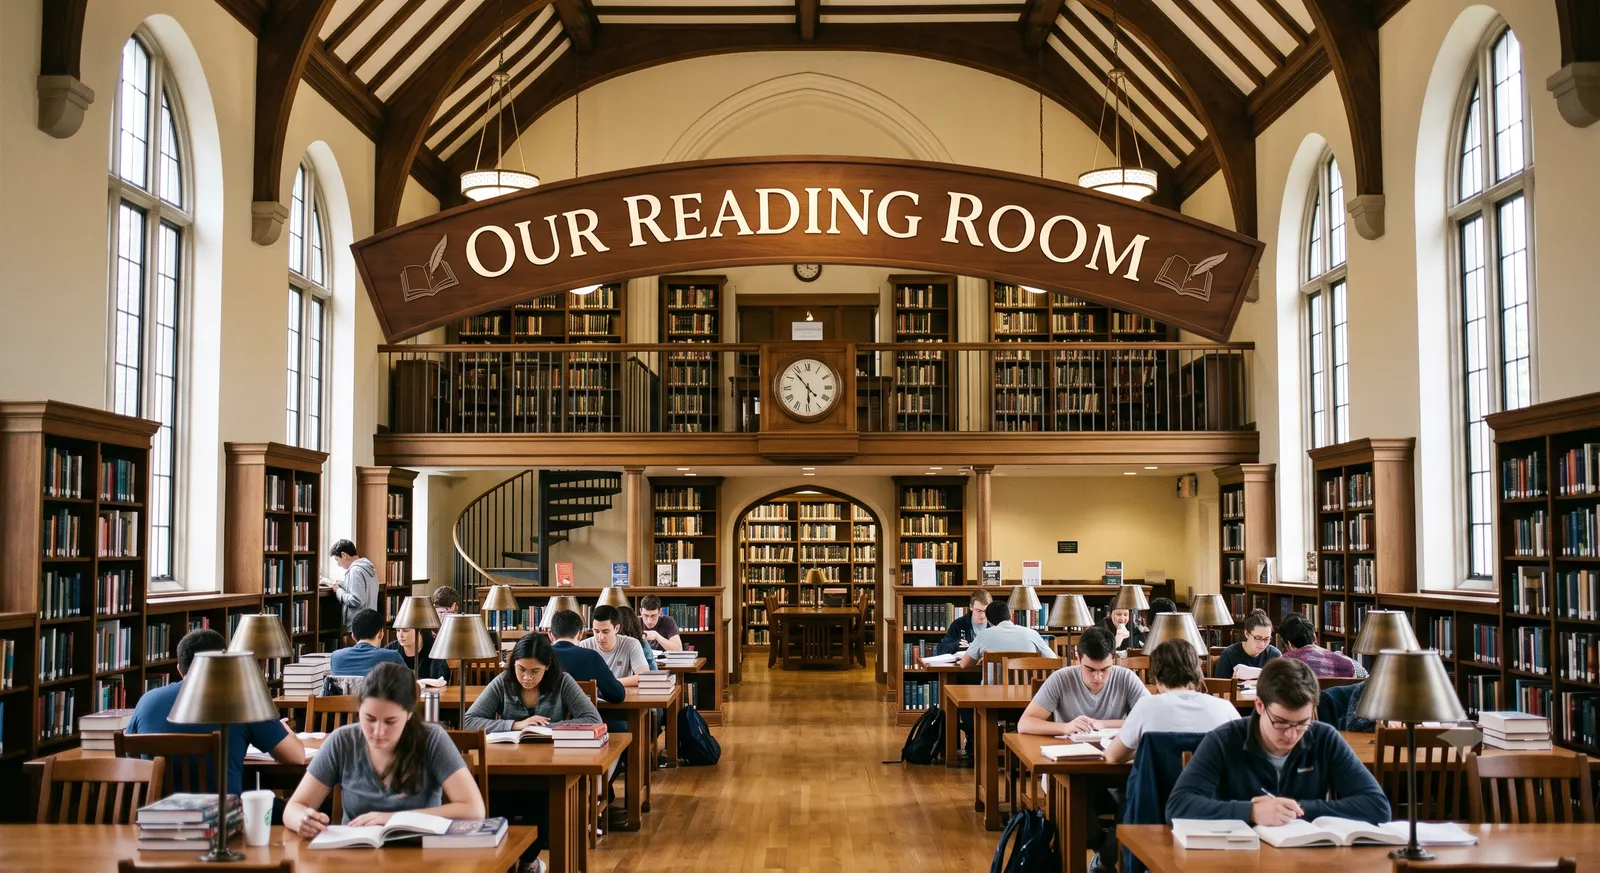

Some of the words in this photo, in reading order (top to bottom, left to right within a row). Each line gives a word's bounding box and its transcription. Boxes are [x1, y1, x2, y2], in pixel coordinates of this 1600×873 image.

[465, 207, 610, 279] OUR
[622, 186, 923, 248] READING
[940, 190, 1151, 283] ROOM
